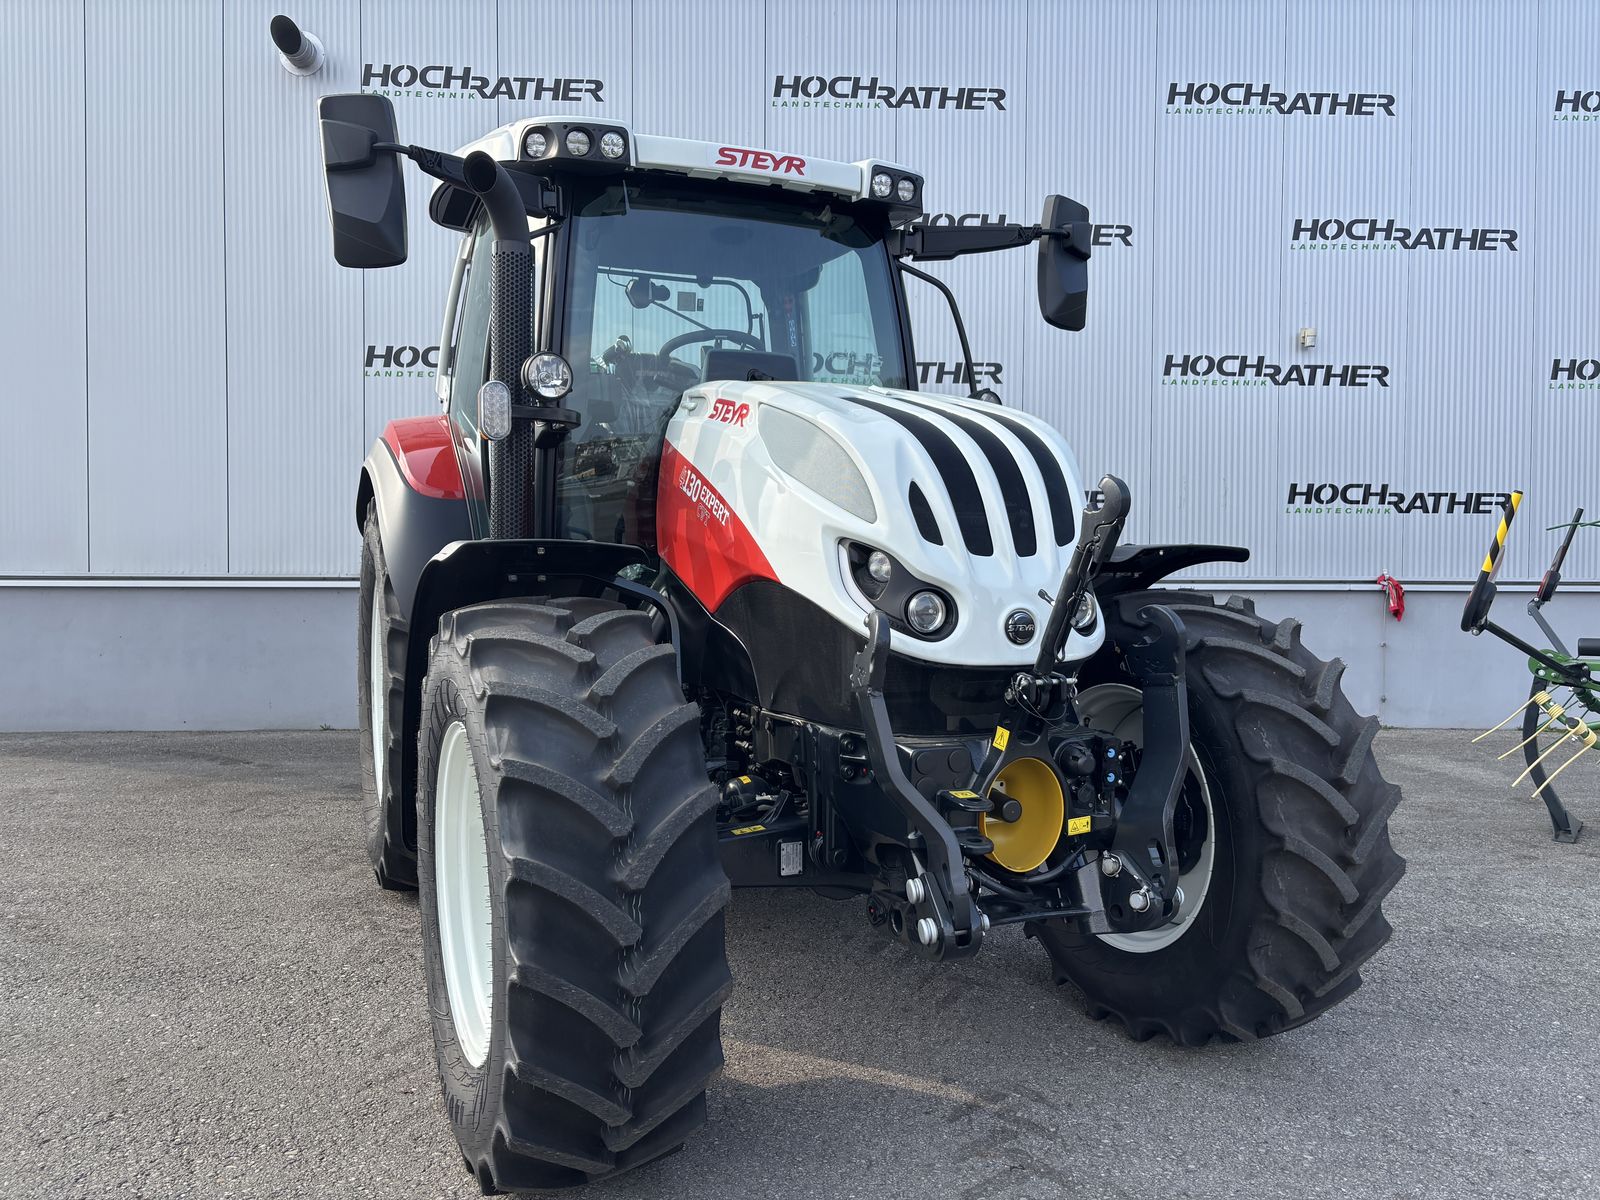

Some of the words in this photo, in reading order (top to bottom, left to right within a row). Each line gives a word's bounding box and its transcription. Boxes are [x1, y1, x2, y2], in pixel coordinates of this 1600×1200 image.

[362, 64, 604, 102] HOCHRATHER
[773, 75, 1006, 111] HOCHRATHER
[772, 100, 881, 109] LANDTECHNIK
[1166, 107, 1273, 115] LANDTECHNIK
[1167, 83, 1396, 116] HOCHRATHER
[716, 147, 806, 176] STEYR
[1291, 219, 1518, 251] HOCHRATHER
[1163, 354, 1390, 387] HOCHRATHER
[708, 398, 750, 427] STEYR
[700, 485, 730, 526] EXPERT
[1285, 507, 1391, 515] LANDTECHNIK
[1008, 624, 1035, 632] STEYR
